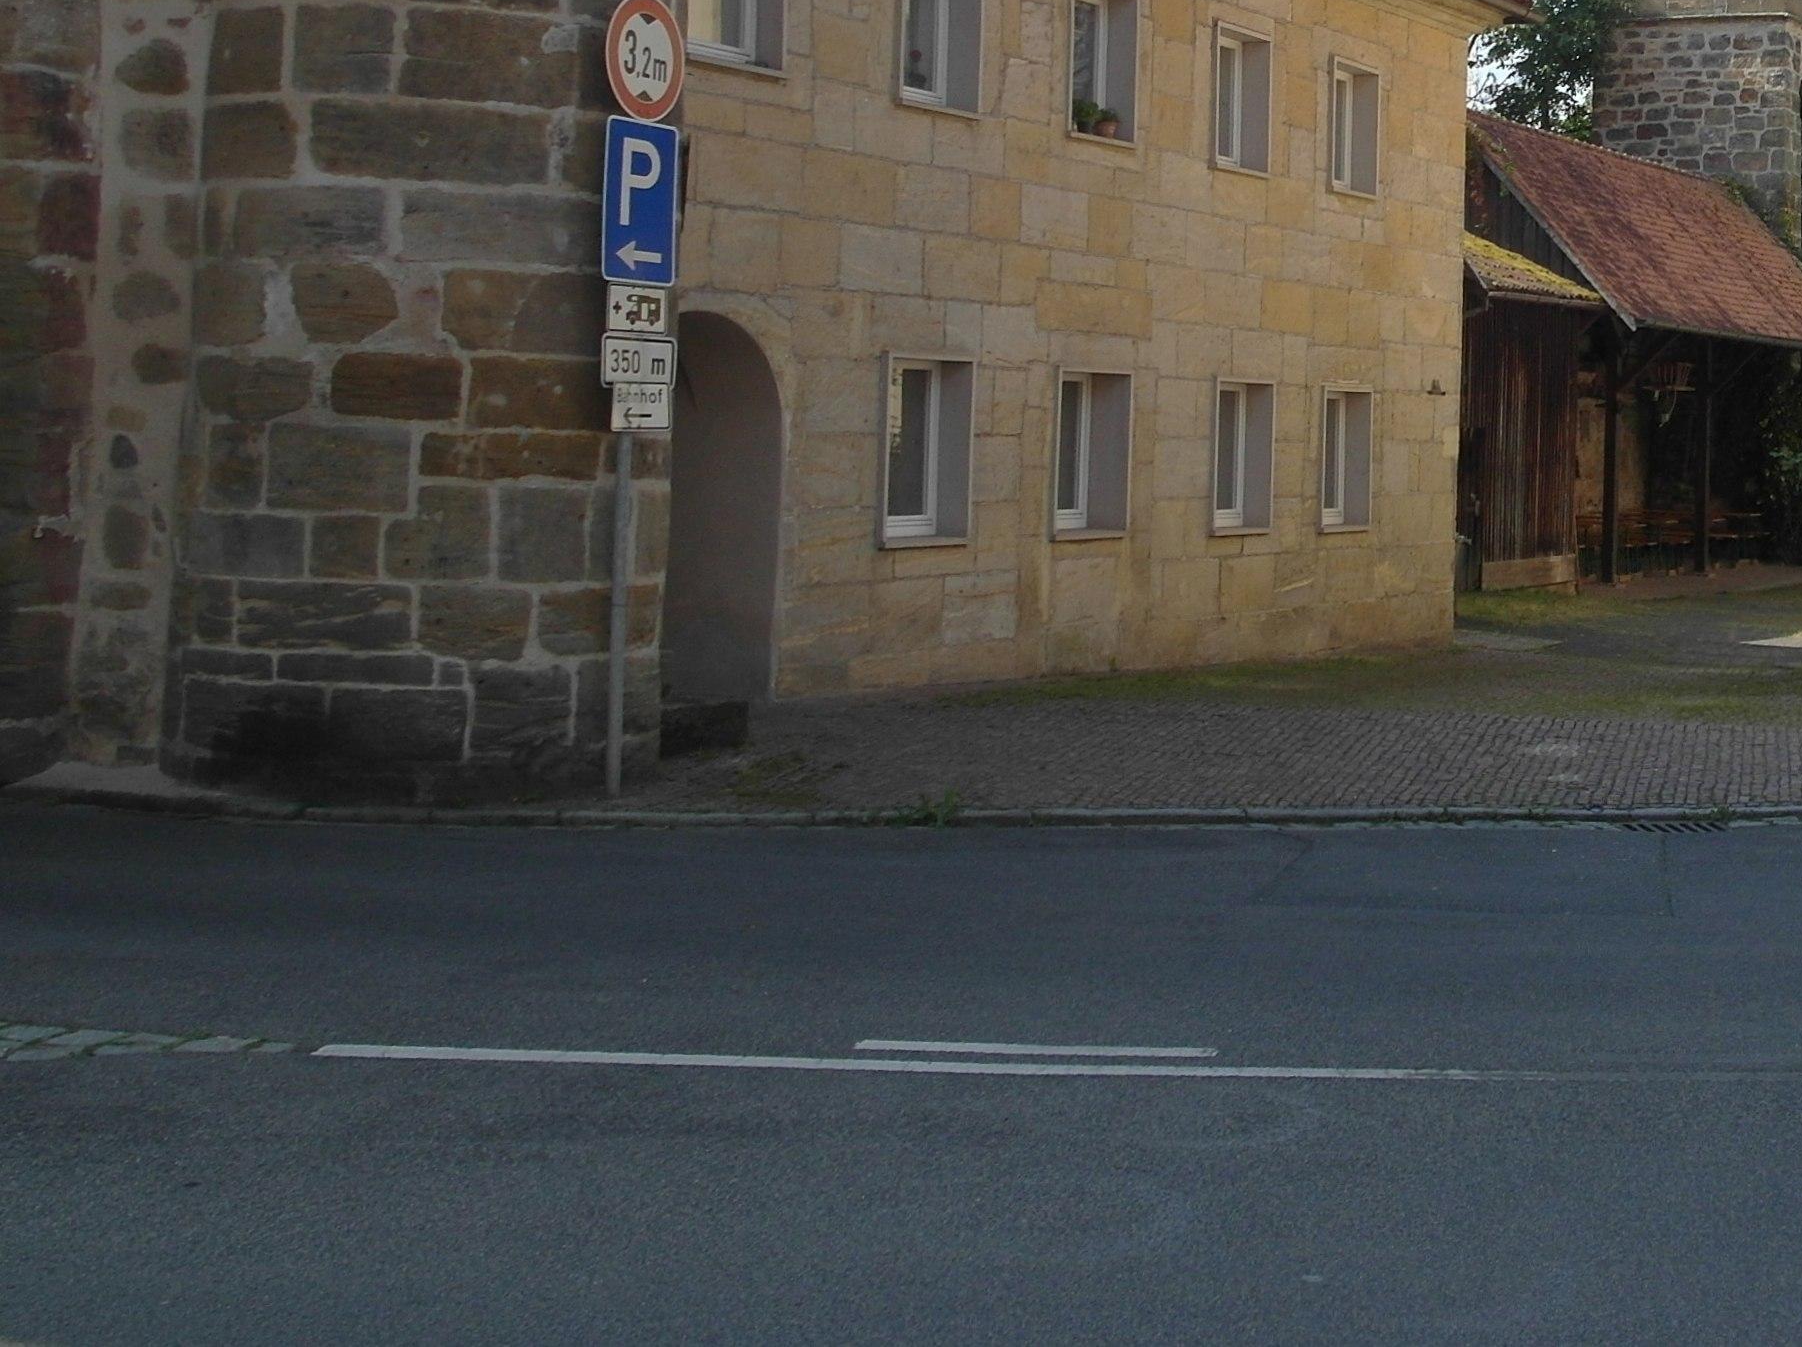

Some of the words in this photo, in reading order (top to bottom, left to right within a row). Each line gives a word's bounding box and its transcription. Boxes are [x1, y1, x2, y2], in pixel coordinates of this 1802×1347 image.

[619, 137, 661, 226] P
[611, 349, 641, 374] 350
[651, 358, 666, 376] m
